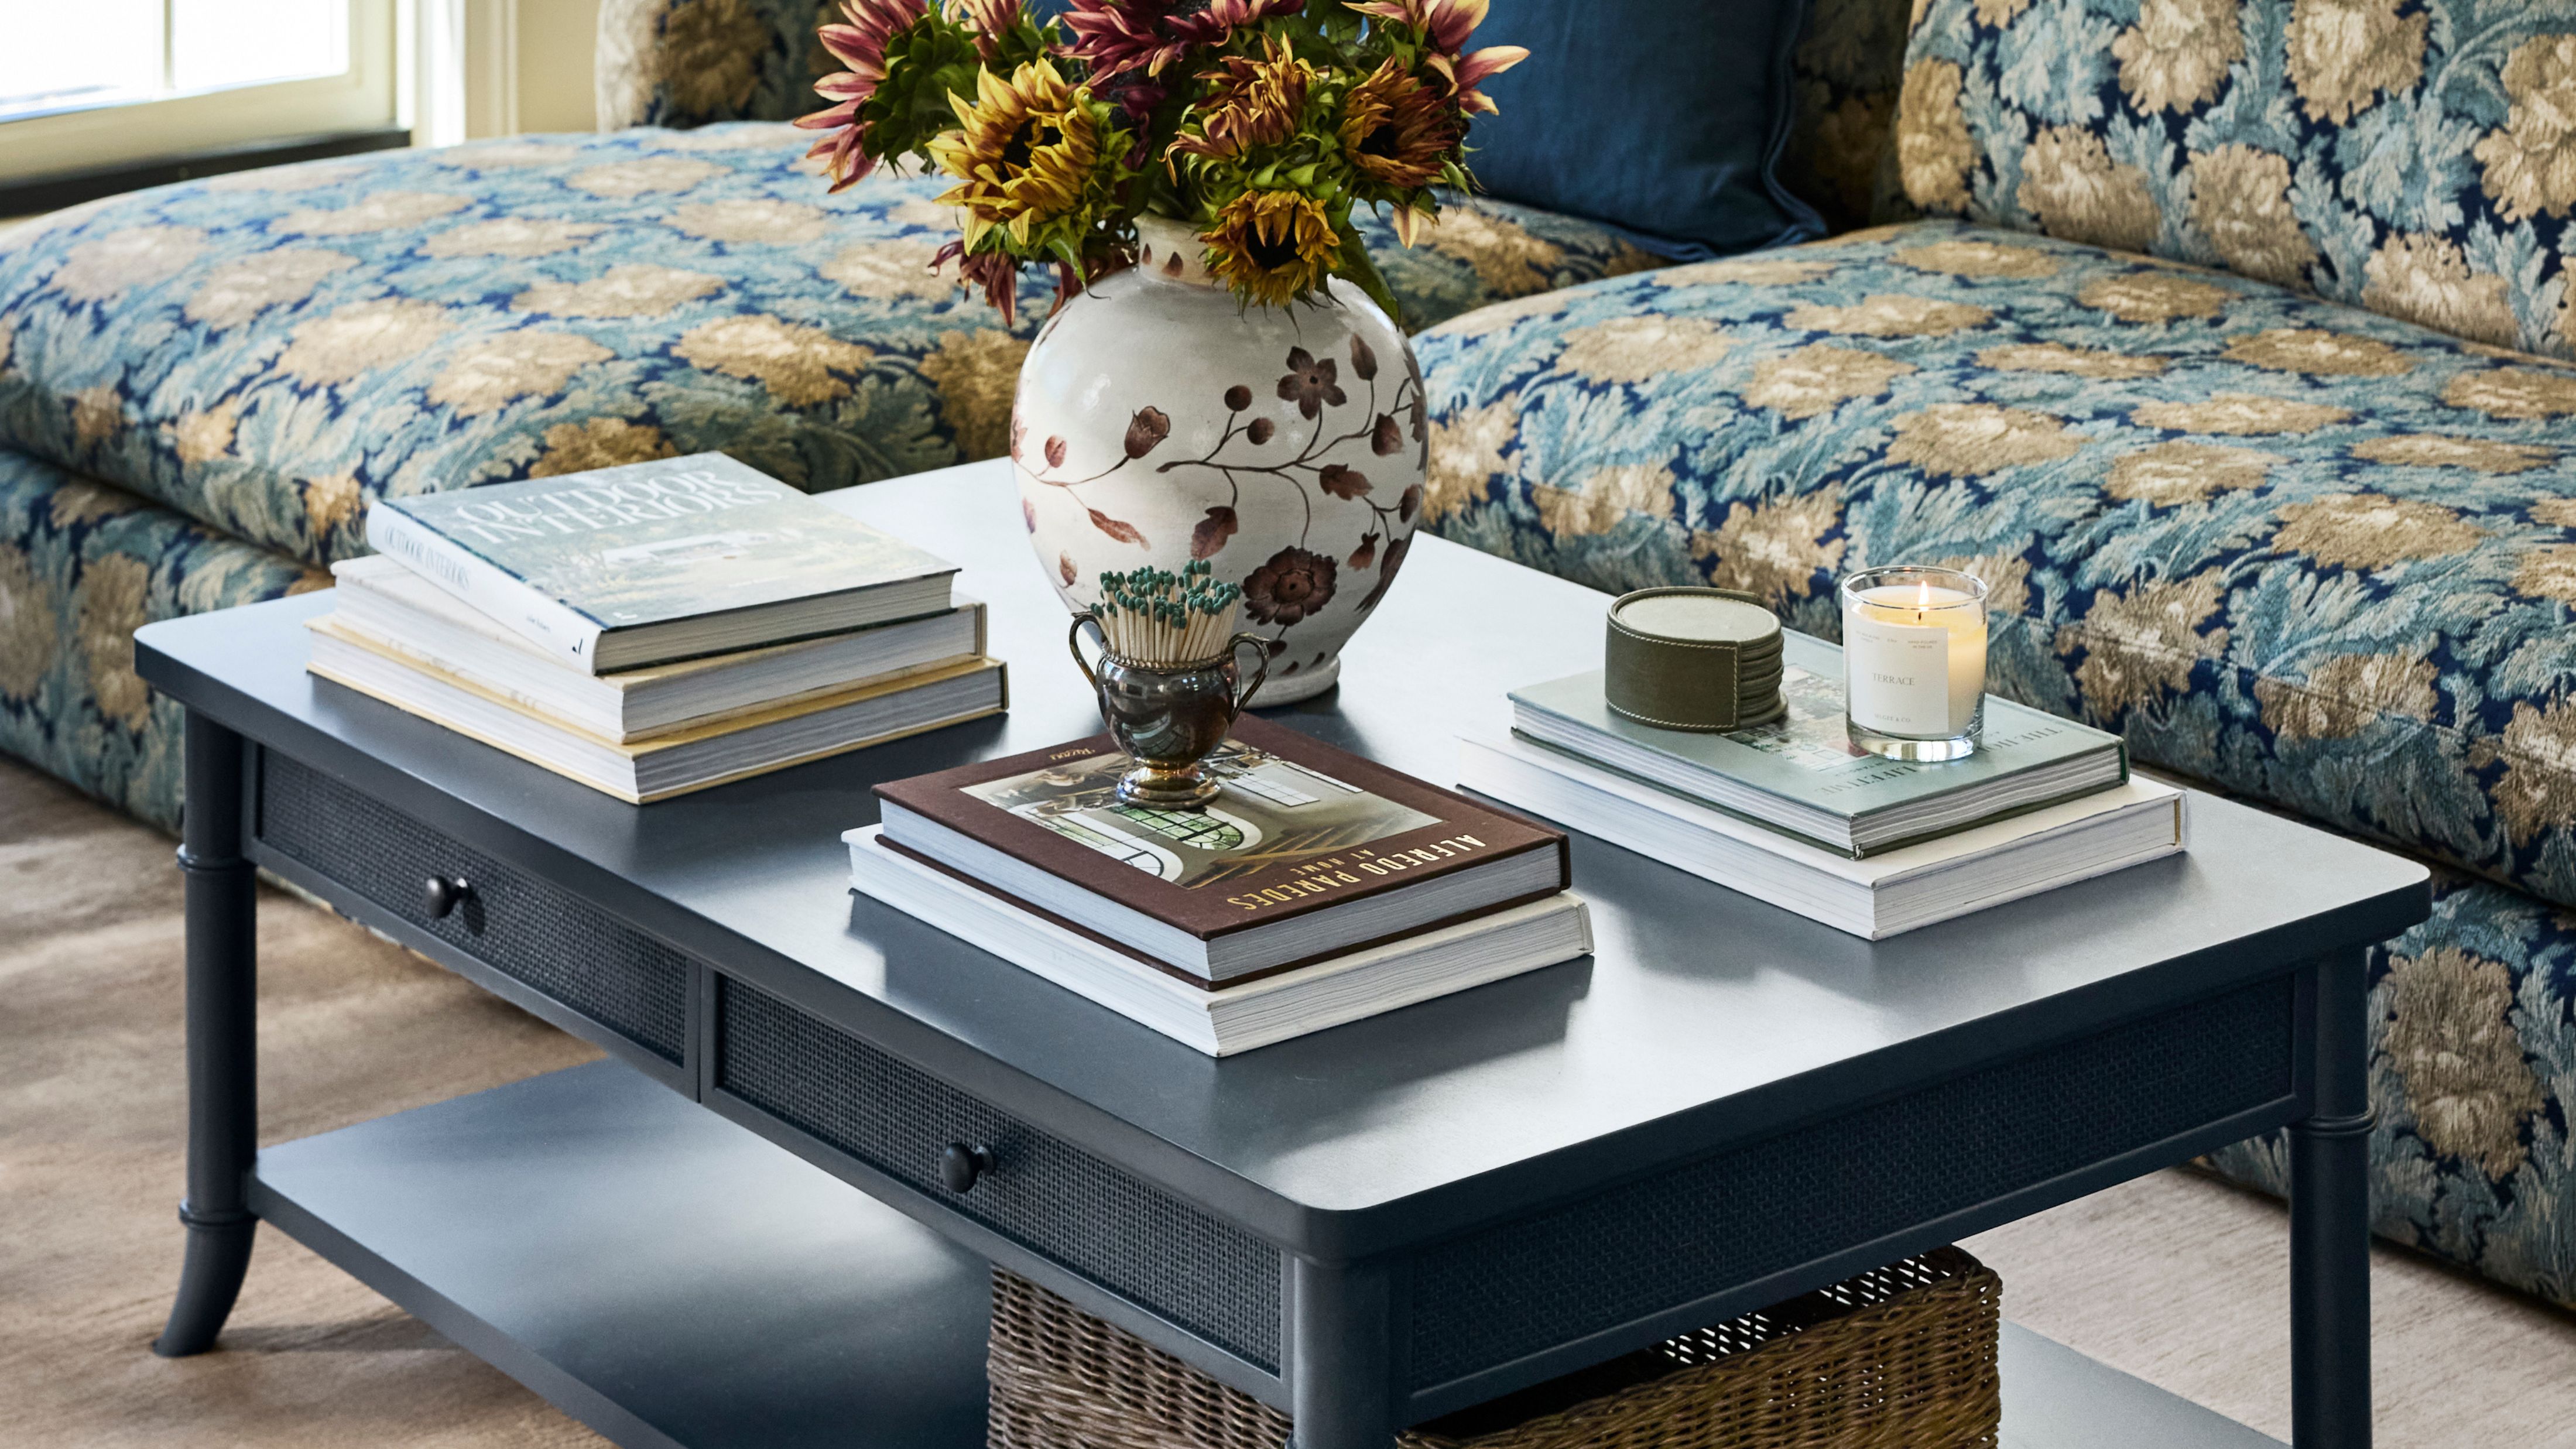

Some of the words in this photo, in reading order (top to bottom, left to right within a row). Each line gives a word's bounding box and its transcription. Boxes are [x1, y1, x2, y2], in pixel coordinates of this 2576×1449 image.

[456, 470, 738, 523] OUTDOOR
[467, 482, 782, 544] INTERIORS
[1872, 672, 1915, 686] TERRACE
[1814, 766, 1917, 795] LIFETIME
[1290, 857, 1346, 876] HOME
[1349, 848, 1375, 860] AT
[1358, 834, 1486, 876] ALFREDO
[1227, 870, 1361, 910] PAREDES
